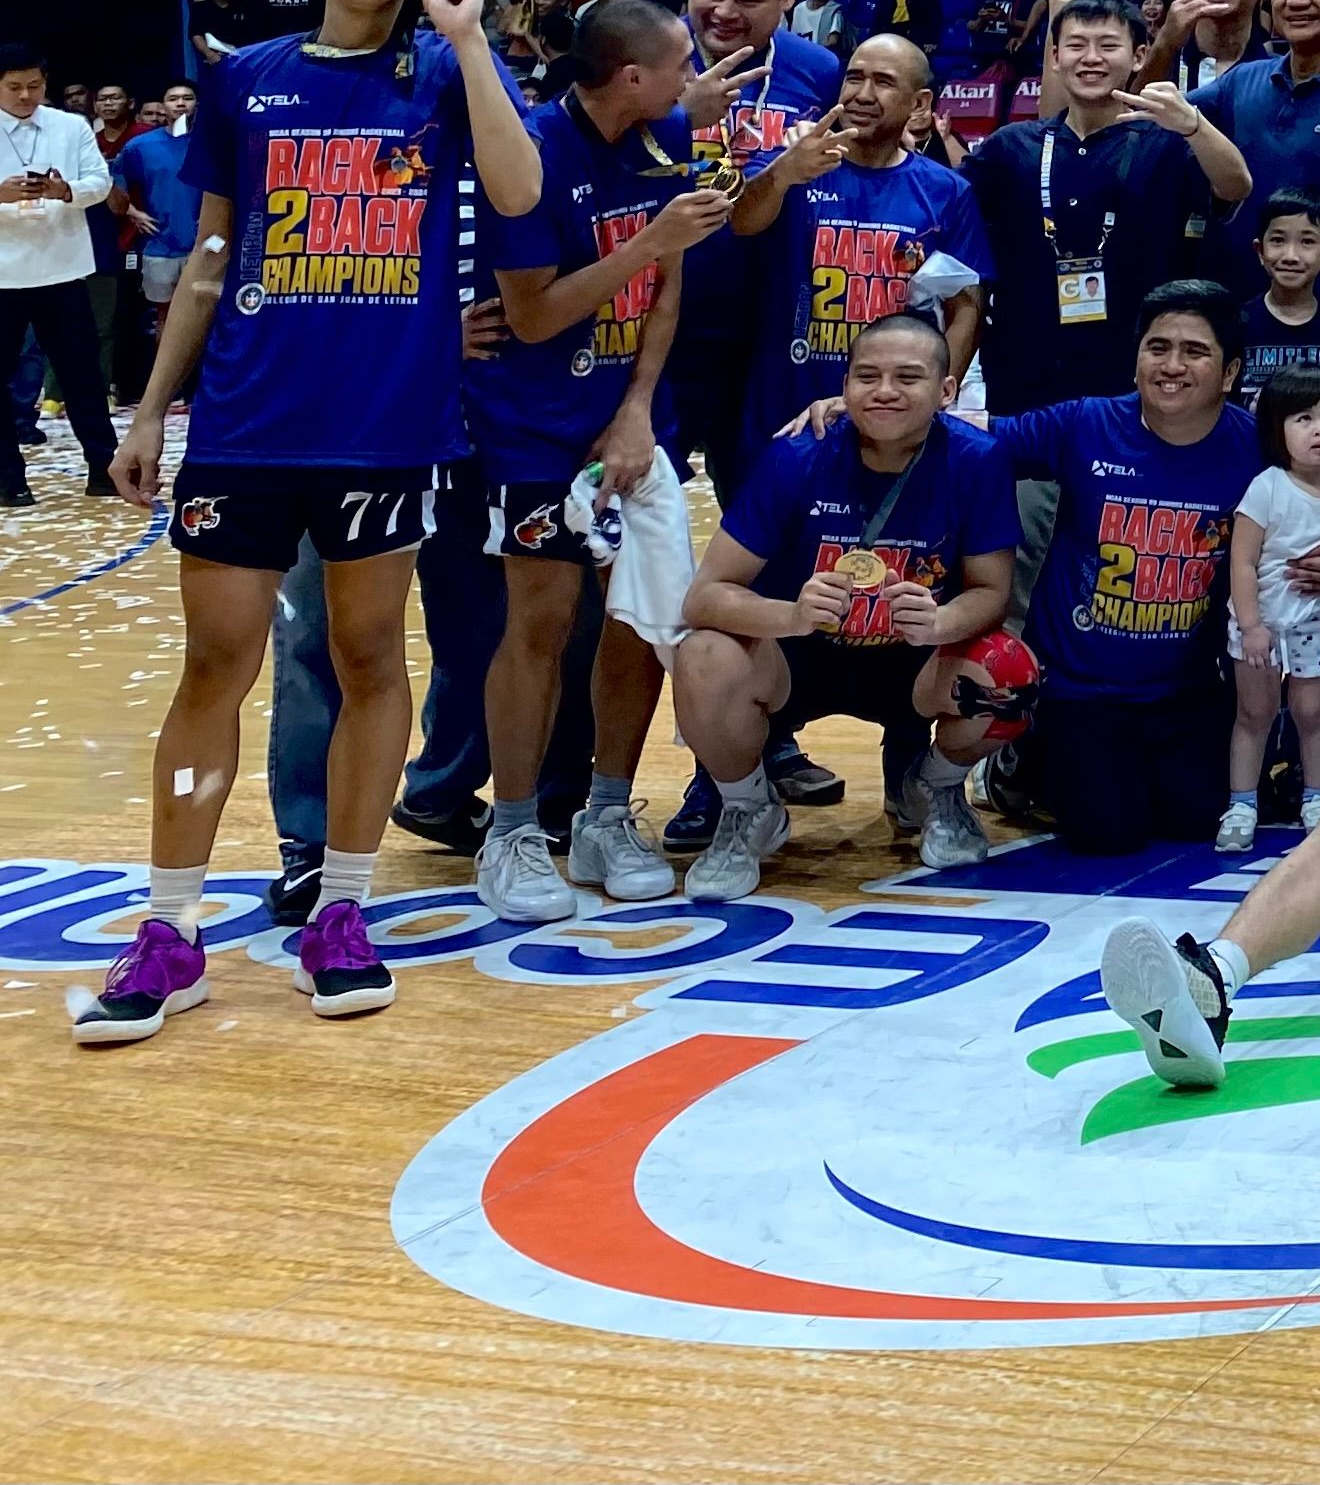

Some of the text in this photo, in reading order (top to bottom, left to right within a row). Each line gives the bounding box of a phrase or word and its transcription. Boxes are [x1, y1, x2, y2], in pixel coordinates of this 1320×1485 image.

[266, 94, 300, 106] TELA
[940, 83, 995, 99] Akari
[266, 138, 382, 196] BACK
[266, 189, 428, 256] 2 BACK
[263, 256, 421, 295] CHAMPIONS
[812, 227, 900, 277] BACK
[811, 267, 847, 320] 2
[1107, 463, 1136, 476] TELA
[340, 491, 406, 542] 77
[822, 502, 851, 514] TELA
[1098, 502, 1201, 558] BACK
[1096, 544, 1136, 598] 2
